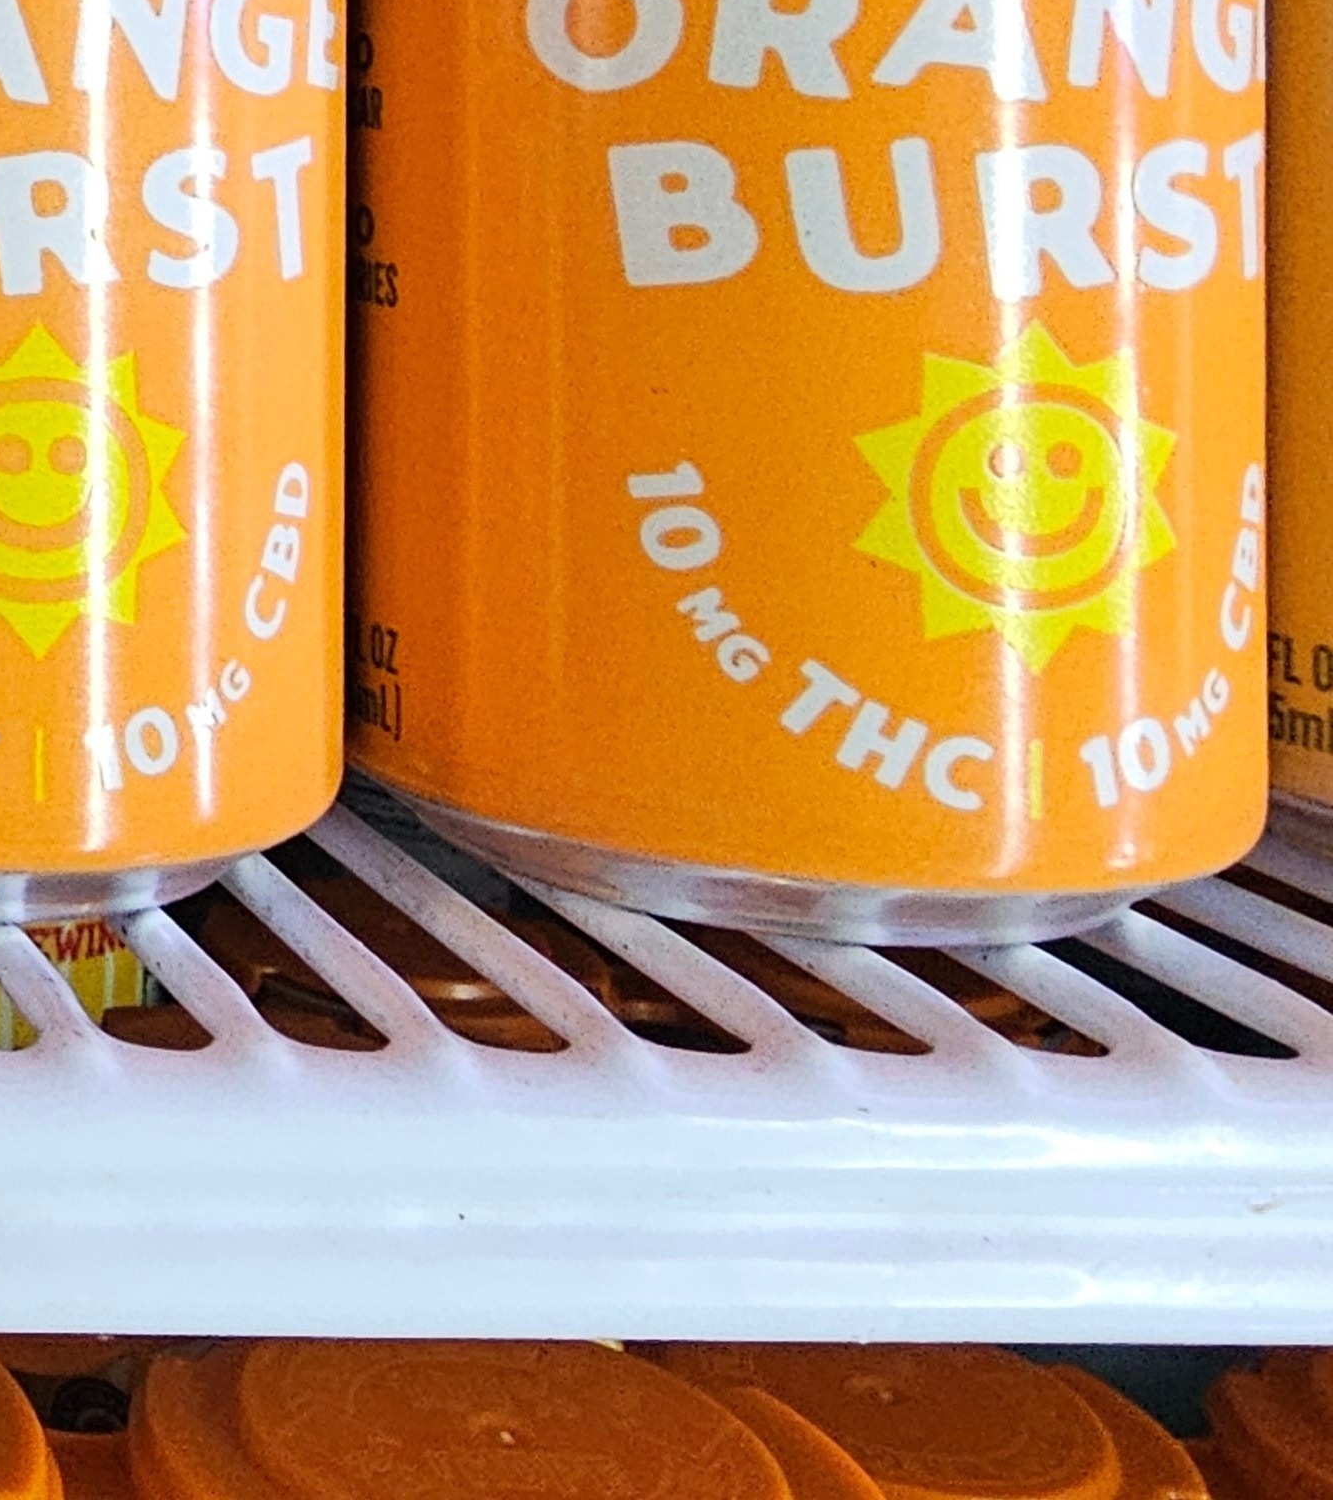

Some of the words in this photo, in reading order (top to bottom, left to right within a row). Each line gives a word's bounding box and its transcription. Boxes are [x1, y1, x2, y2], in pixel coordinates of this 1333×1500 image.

[606, 129, 1264, 298] BURST
[245, 459, 309, 641] CBD
[782, 658, 996, 813] THC
[1219, 463, 1263, 652] CBD
